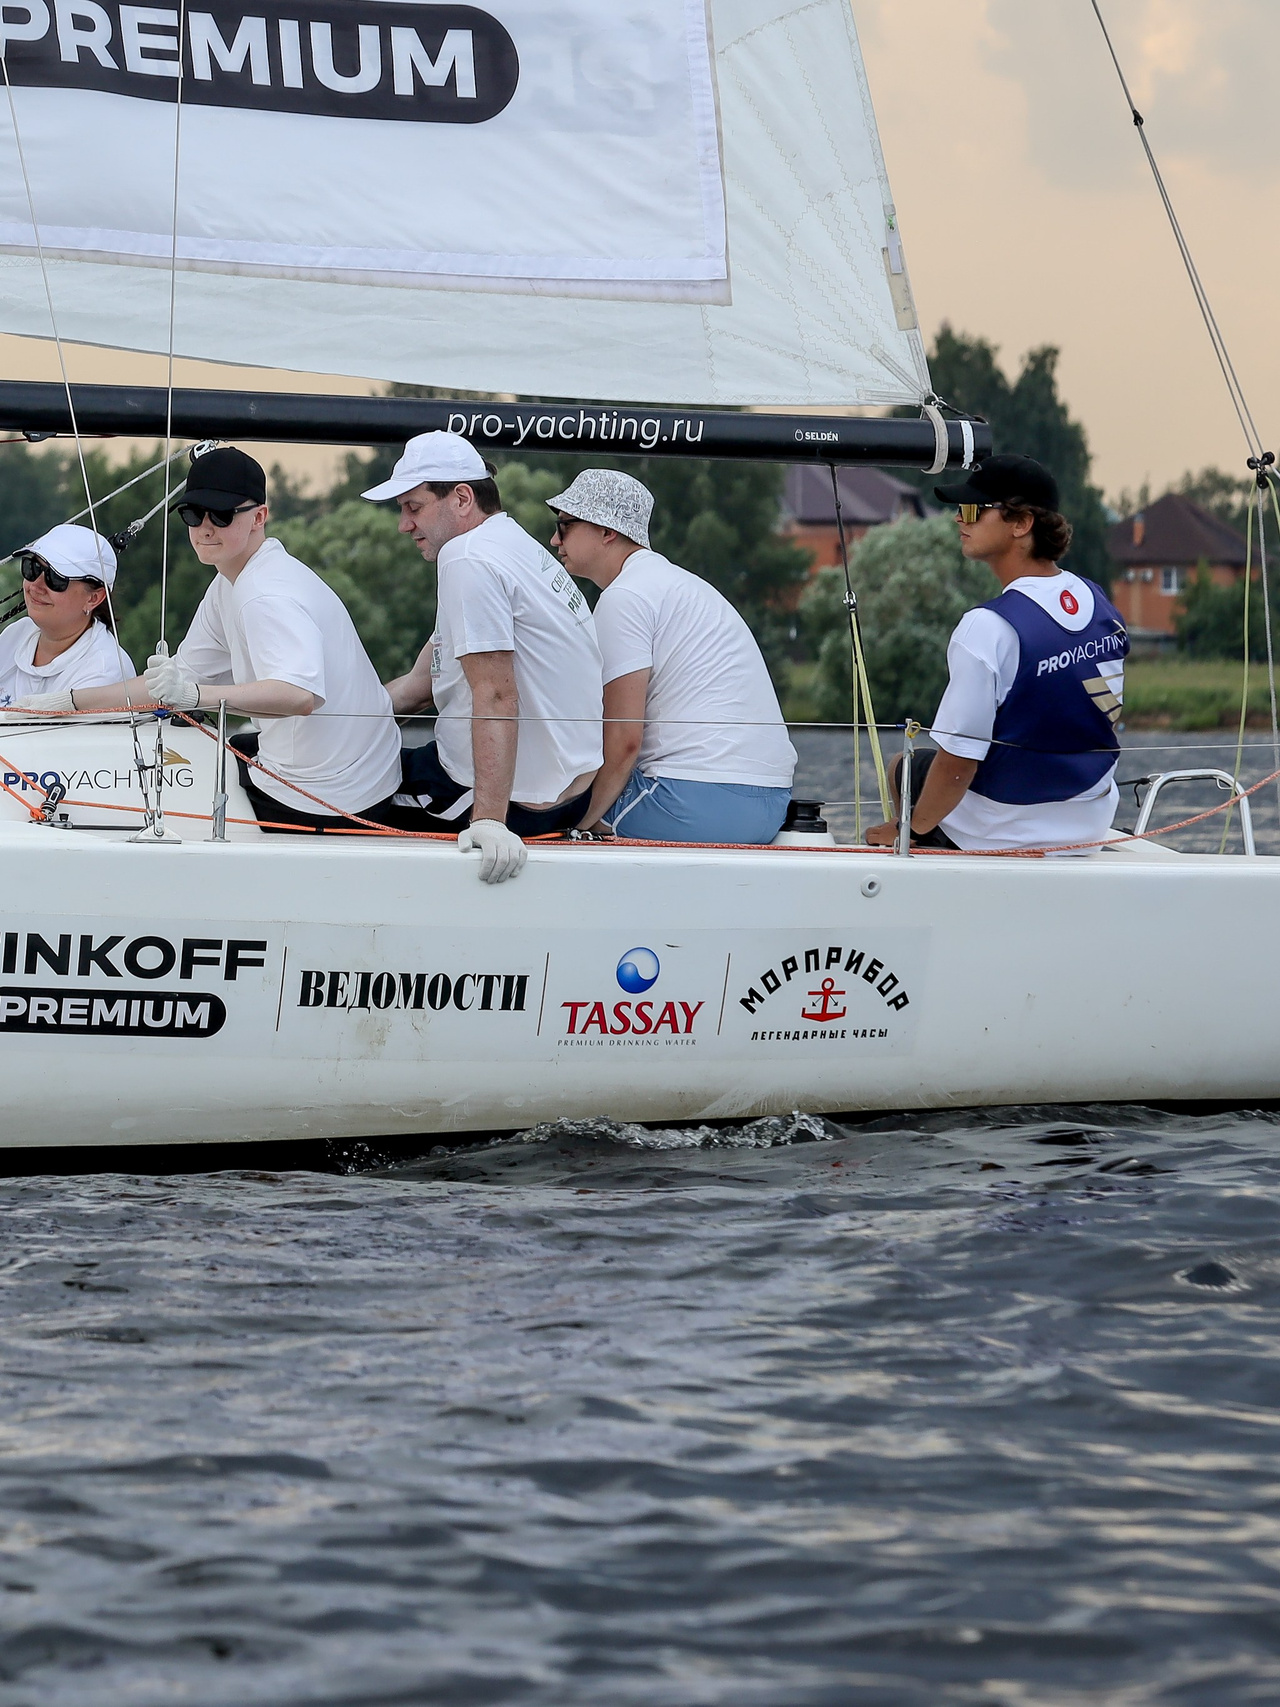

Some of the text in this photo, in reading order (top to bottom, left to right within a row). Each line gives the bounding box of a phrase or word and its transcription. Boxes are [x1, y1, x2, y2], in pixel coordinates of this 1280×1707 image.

[446, 409, 705, 449] pro-yachting.ru
[805, 431, 839, 442] SELDÉN
[1036, 634, 1127, 677] PROYACHTIN
[3, 768, 194, 792] PROYACHING
[296, 970, 530, 1014] ВЕДОМОСТИ
[739, 946, 910, 1015] МОРПРИБОР
[560, 1001, 706, 1035] TASSAY
[750, 1028, 888, 1041] ЛЕГЕНДАРНЫЕ ЧАСЫ
[557, 1038, 697, 1047] PREMIUM DRINKING WATER
